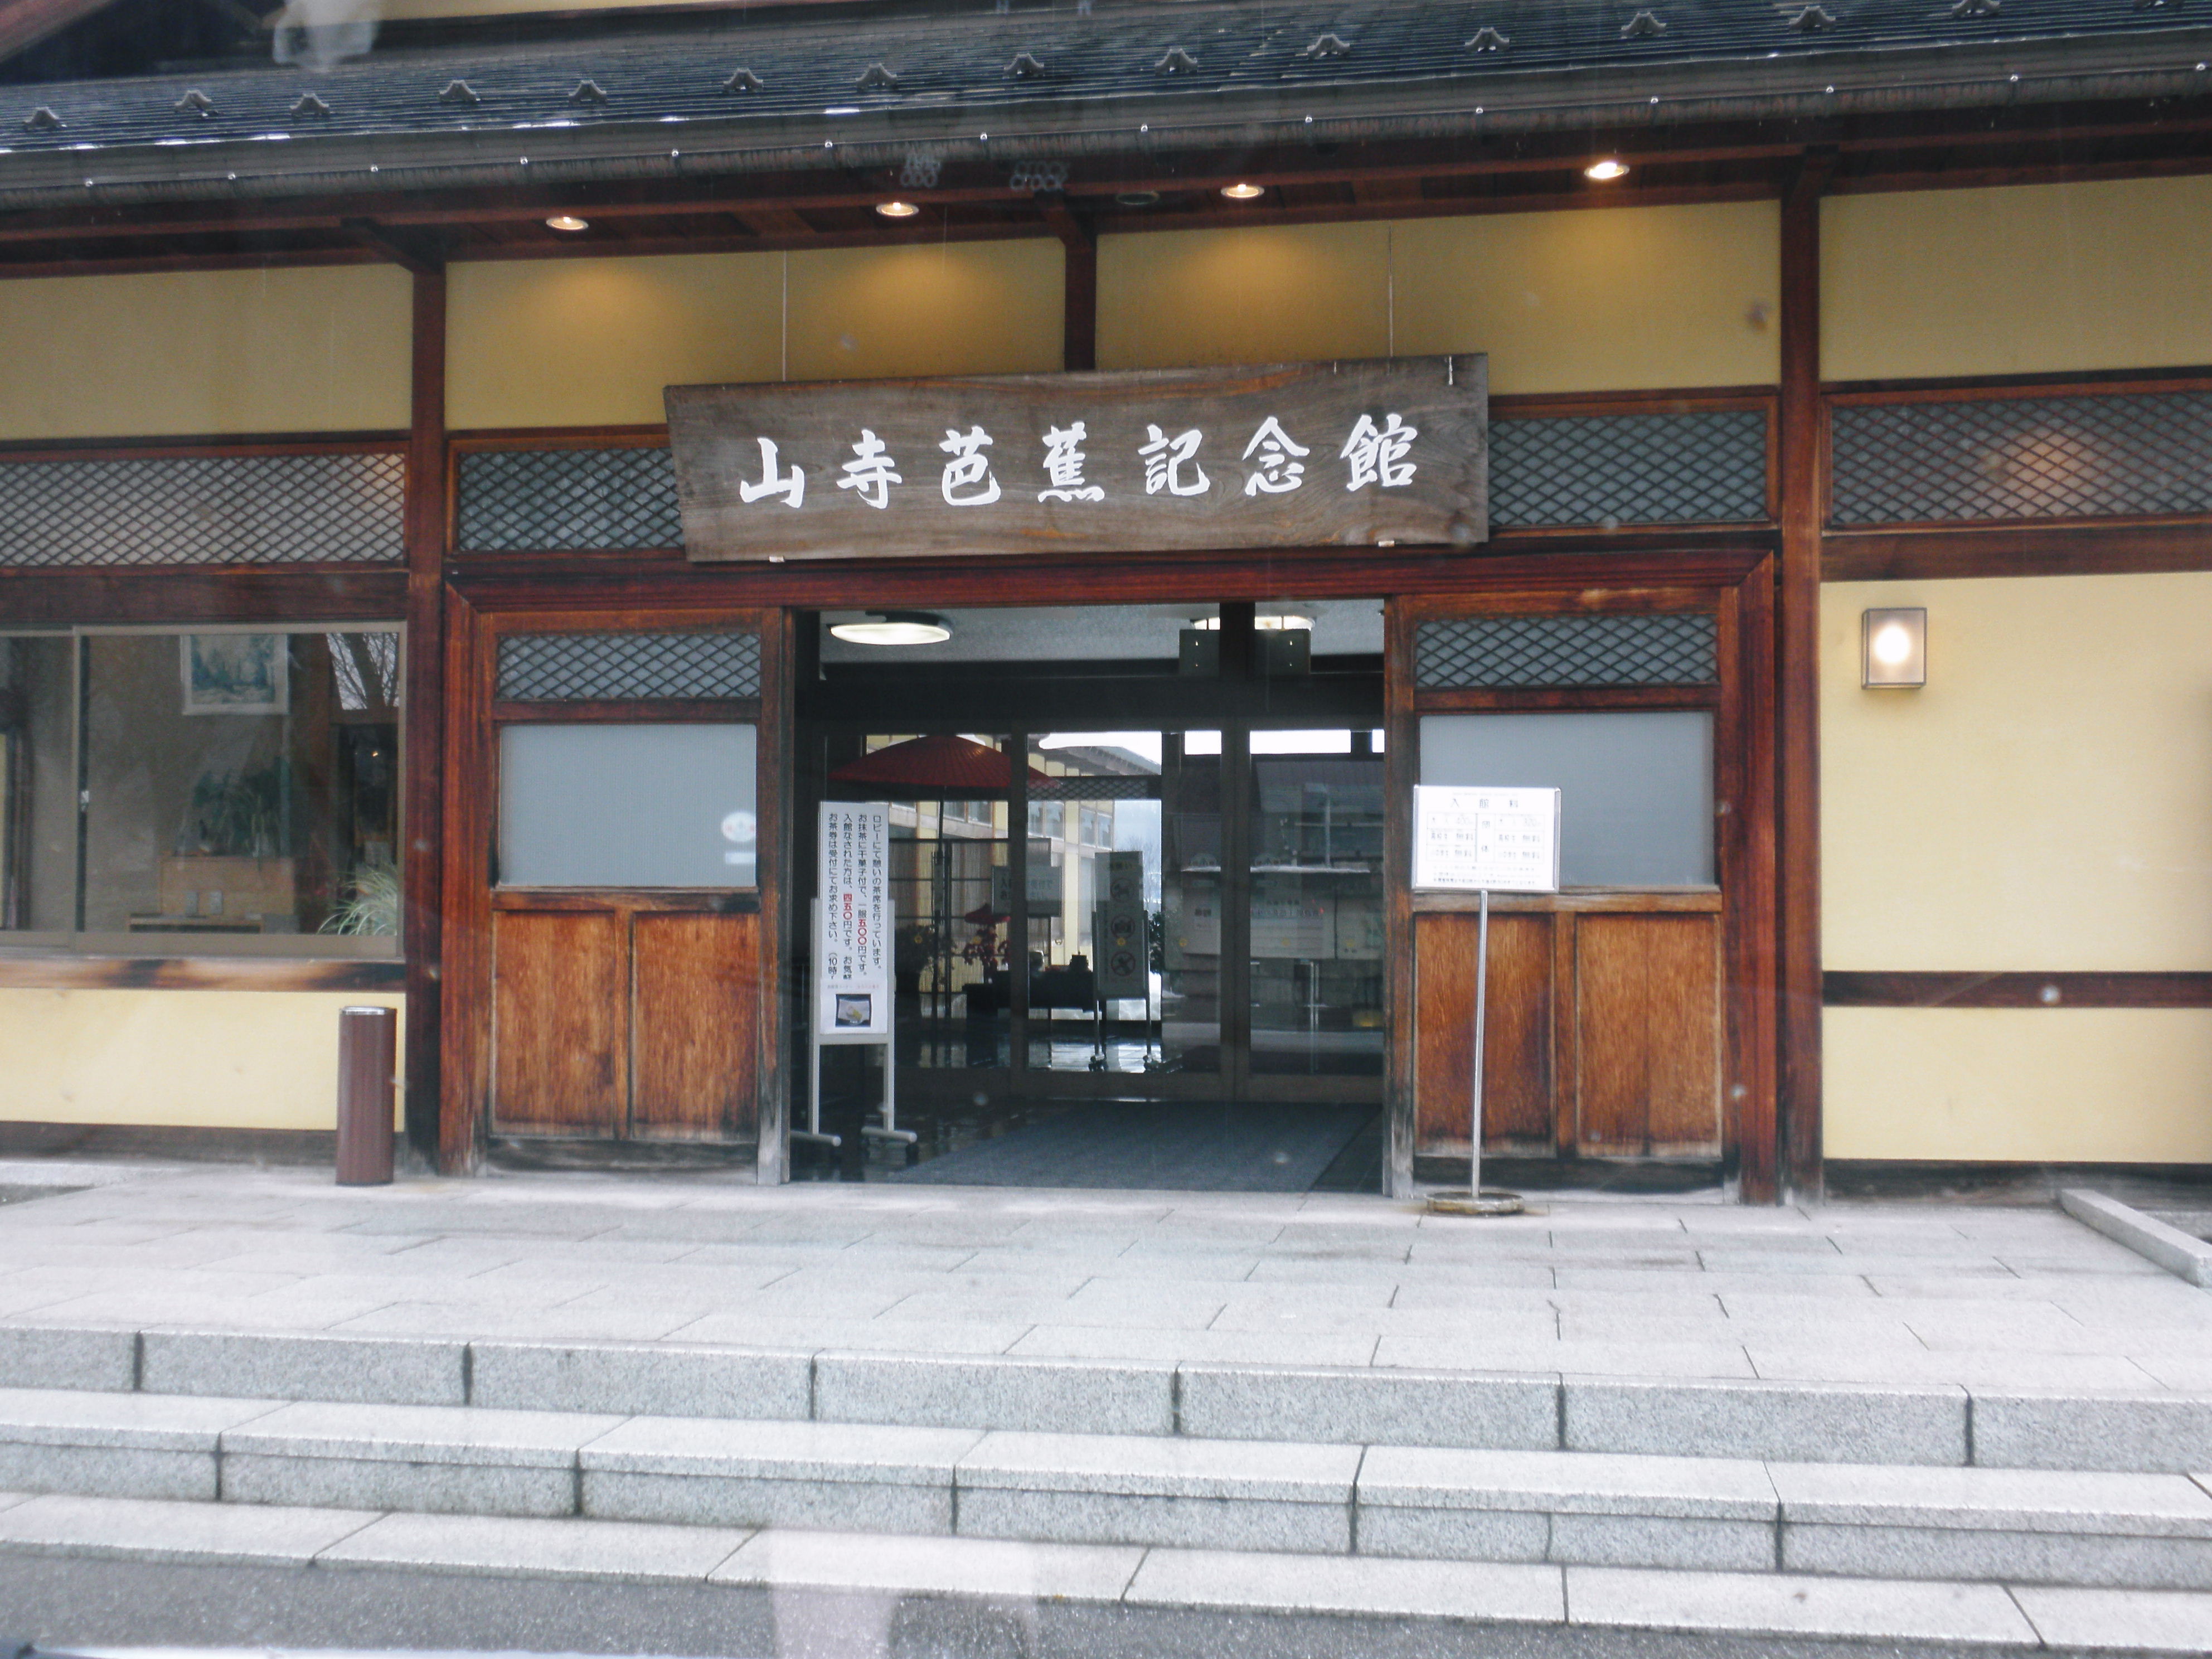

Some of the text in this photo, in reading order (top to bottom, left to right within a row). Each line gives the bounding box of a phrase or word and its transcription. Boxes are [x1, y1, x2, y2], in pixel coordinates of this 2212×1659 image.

[739, 413, 1419, 509] 山寺芭蕉記念館
